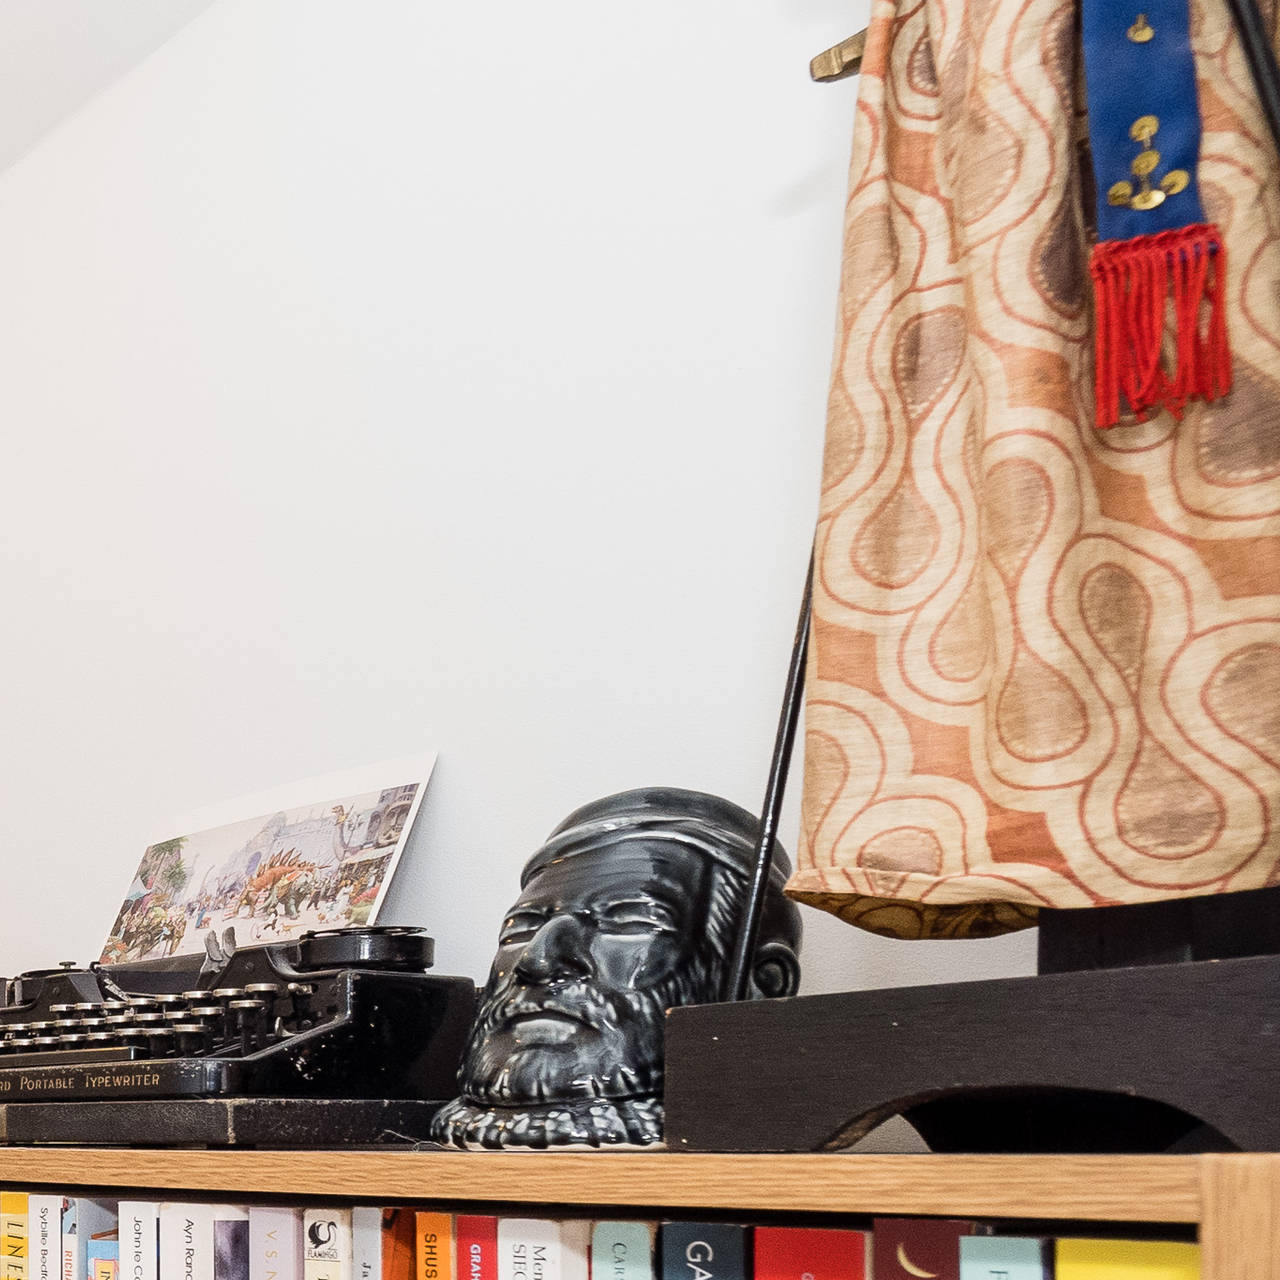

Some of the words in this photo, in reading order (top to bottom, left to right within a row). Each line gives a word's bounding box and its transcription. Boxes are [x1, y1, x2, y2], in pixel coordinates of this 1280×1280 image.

[20, 1075, 75, 1091] PORTABLE
[85, 1073, 160, 1088] TYPEWRITER
[40, 1207, 49, 1246] Sybille
[133, 1217, 143, 1249] John
[184, 1218, 194, 1248] Ayn
[265, 1230, 278, 1242] V.
[134, 1252, 143, 1263] le
[266, 1250, 278, 1265] S.
[307, 1249, 339, 1260] FLAMINGO
